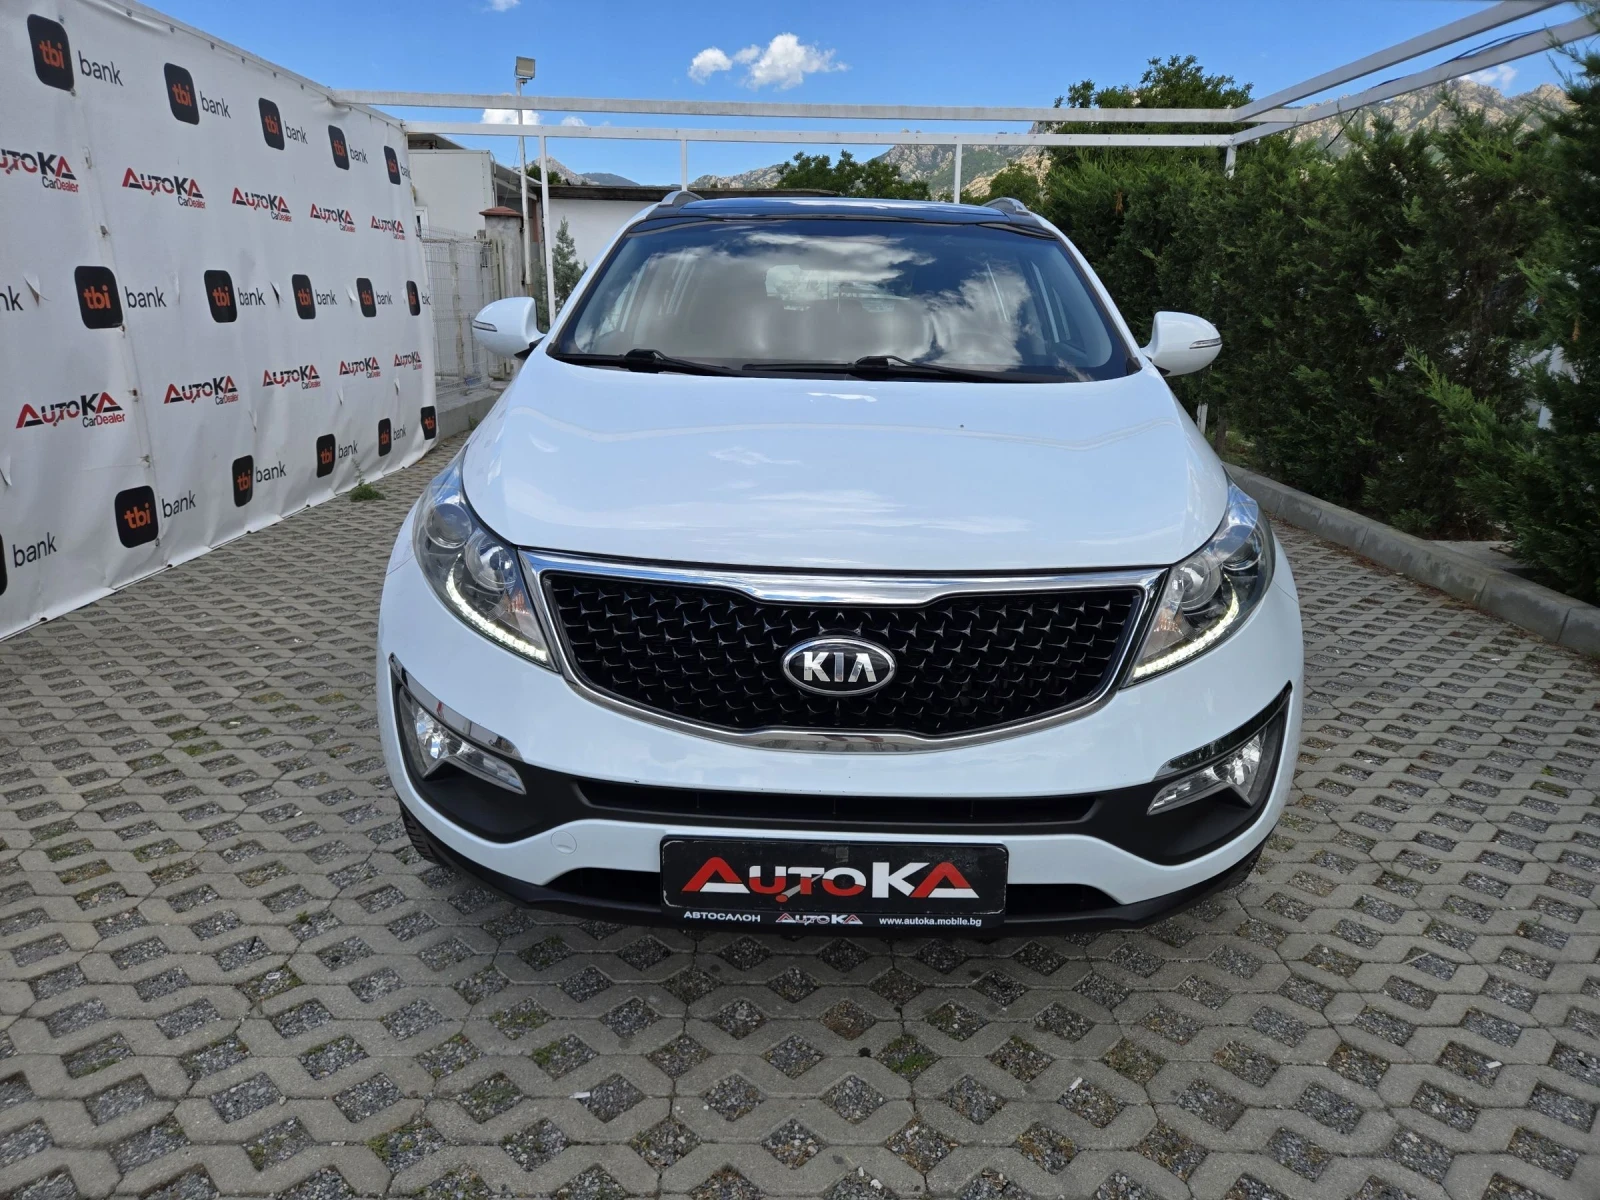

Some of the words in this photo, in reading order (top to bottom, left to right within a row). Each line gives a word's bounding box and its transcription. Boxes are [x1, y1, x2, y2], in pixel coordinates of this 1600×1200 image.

[39, 40, 65, 69] tbi
[78, 50, 124, 86] bank
[172, 83, 192, 107] tbi
[199, 90, 231, 119] bank
[264, 115, 280, 135] tbi
[284, 121, 308, 144] bank
[333, 140, 345, 157] tbi
[349, 144, 368, 164] bank
[0, 149, 77, 181] UTOKA
[41, 175, 79, 193] CarDealer
[122, 167, 204, 199] AUTOKA
[231, 187, 291, 214] AUTOKA
[310, 203, 355, 225] AUTOKA
[0, 285, 24, 311] nk
[83, 284, 112, 309] tbi
[124, 285, 167, 309] bank
[212, 286, 230, 307] tbi
[237, 287, 266, 306] bank
[298, 288, 311, 306] tbi
[315, 289, 338, 306] bank
[362, 291, 373, 306] tbi
[375, 291, 393, 306] bank
[262, 364, 320, 388] AUTOKA
[339, 356, 380, 376] AUTOKA
[163, 375, 238, 405] AUTOKA
[15, 391, 123, 429] AUTOKA
[82, 412, 125, 428] CarDealer
[424, 415, 434, 430] tbi
[380, 428, 389, 445] tbi
[393, 424, 407, 441] bank
[320, 446, 333, 465] tbi
[338, 440, 358, 458] bank
[237, 469, 251, 491] tbi
[256, 460, 287, 483] bank
[124, 502, 150, 529] tbi
[162, 490, 196, 518] bank
[12, 532, 57, 568] bank
[802, 651, 877, 682] KIA
[681, 856, 980, 902] AUTOKA
[683, 910, 761, 923] АВТОСАЛОН
[775, 912, 863, 926] AUTOKA
[878, 916, 983, 927] www.autoka.mobile.bg
